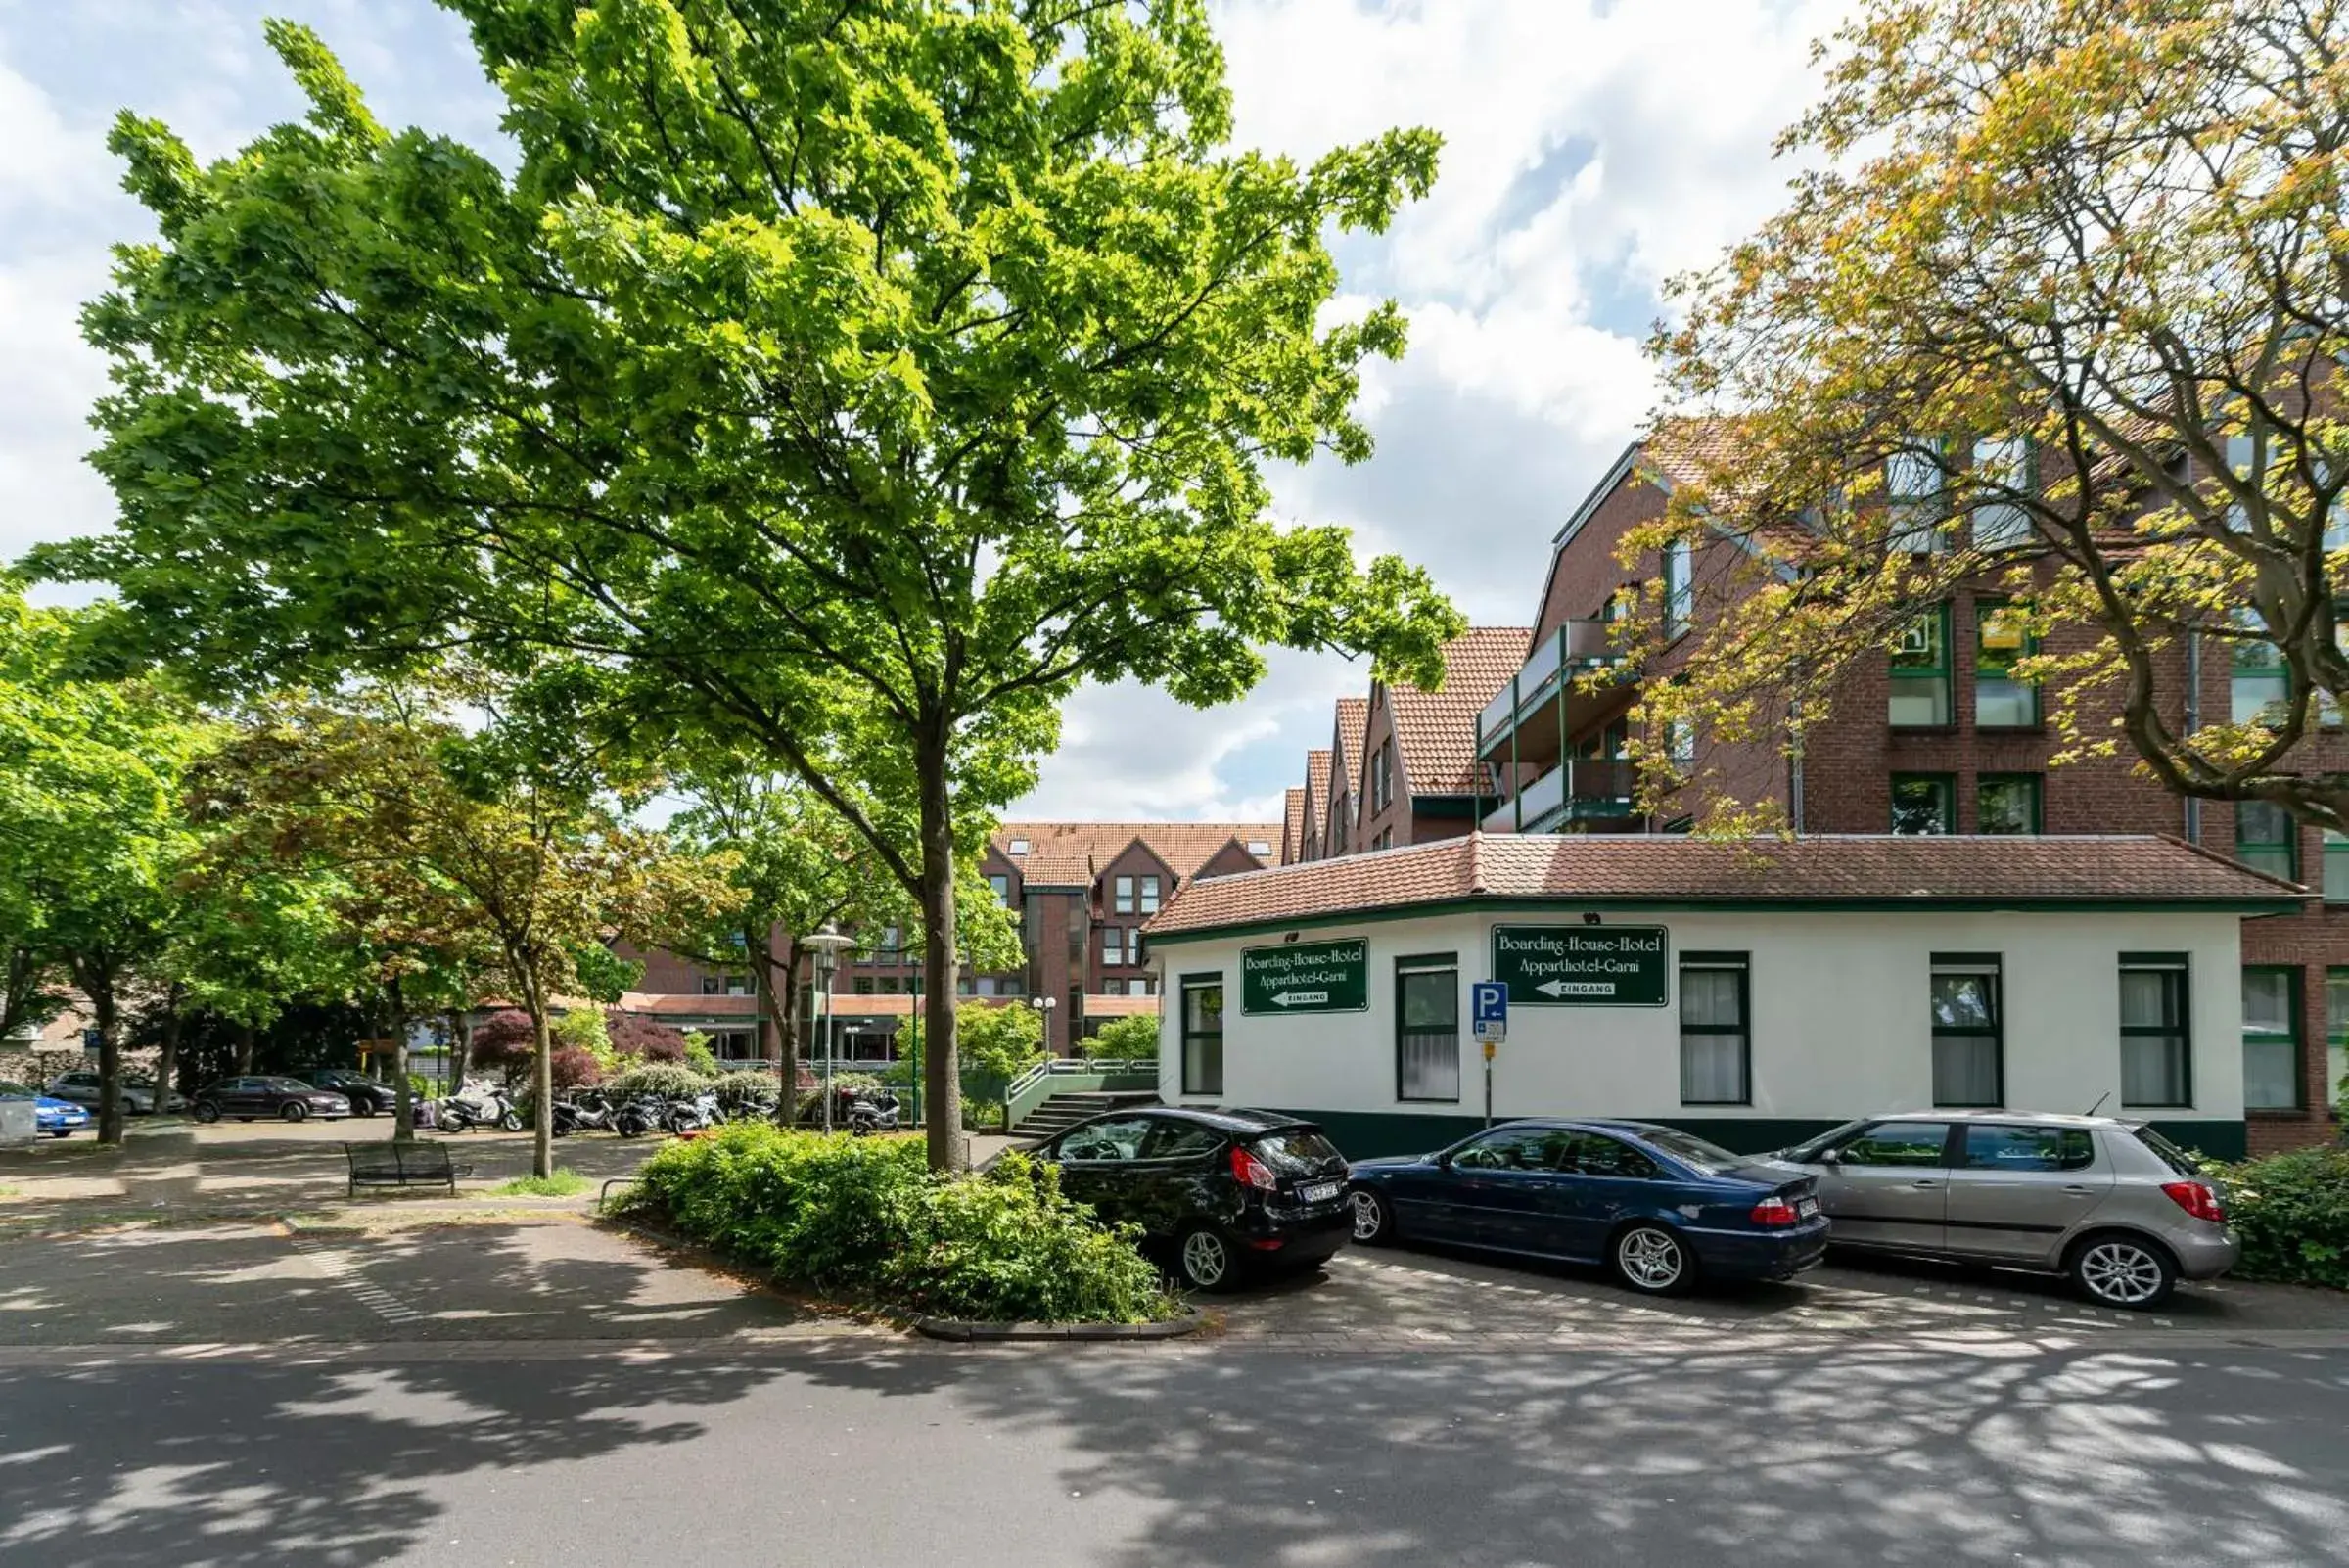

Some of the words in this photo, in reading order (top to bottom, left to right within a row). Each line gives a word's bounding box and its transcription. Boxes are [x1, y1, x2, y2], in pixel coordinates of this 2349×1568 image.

[1499, 935, 1661, 956] Boarding-House-Hotel
[1246, 947, 1363, 971] Boarding-House-Hotel
[1520, 958, 1640, 976] Apparthotel-Garni
[1260, 970, 1347, 990] Apparthotel-Garni
[1560, 984, 1613, 993] EINGANG
[1287, 993, 1326, 1003] EINGANG
[1479, 988, 1499, 1018] P
